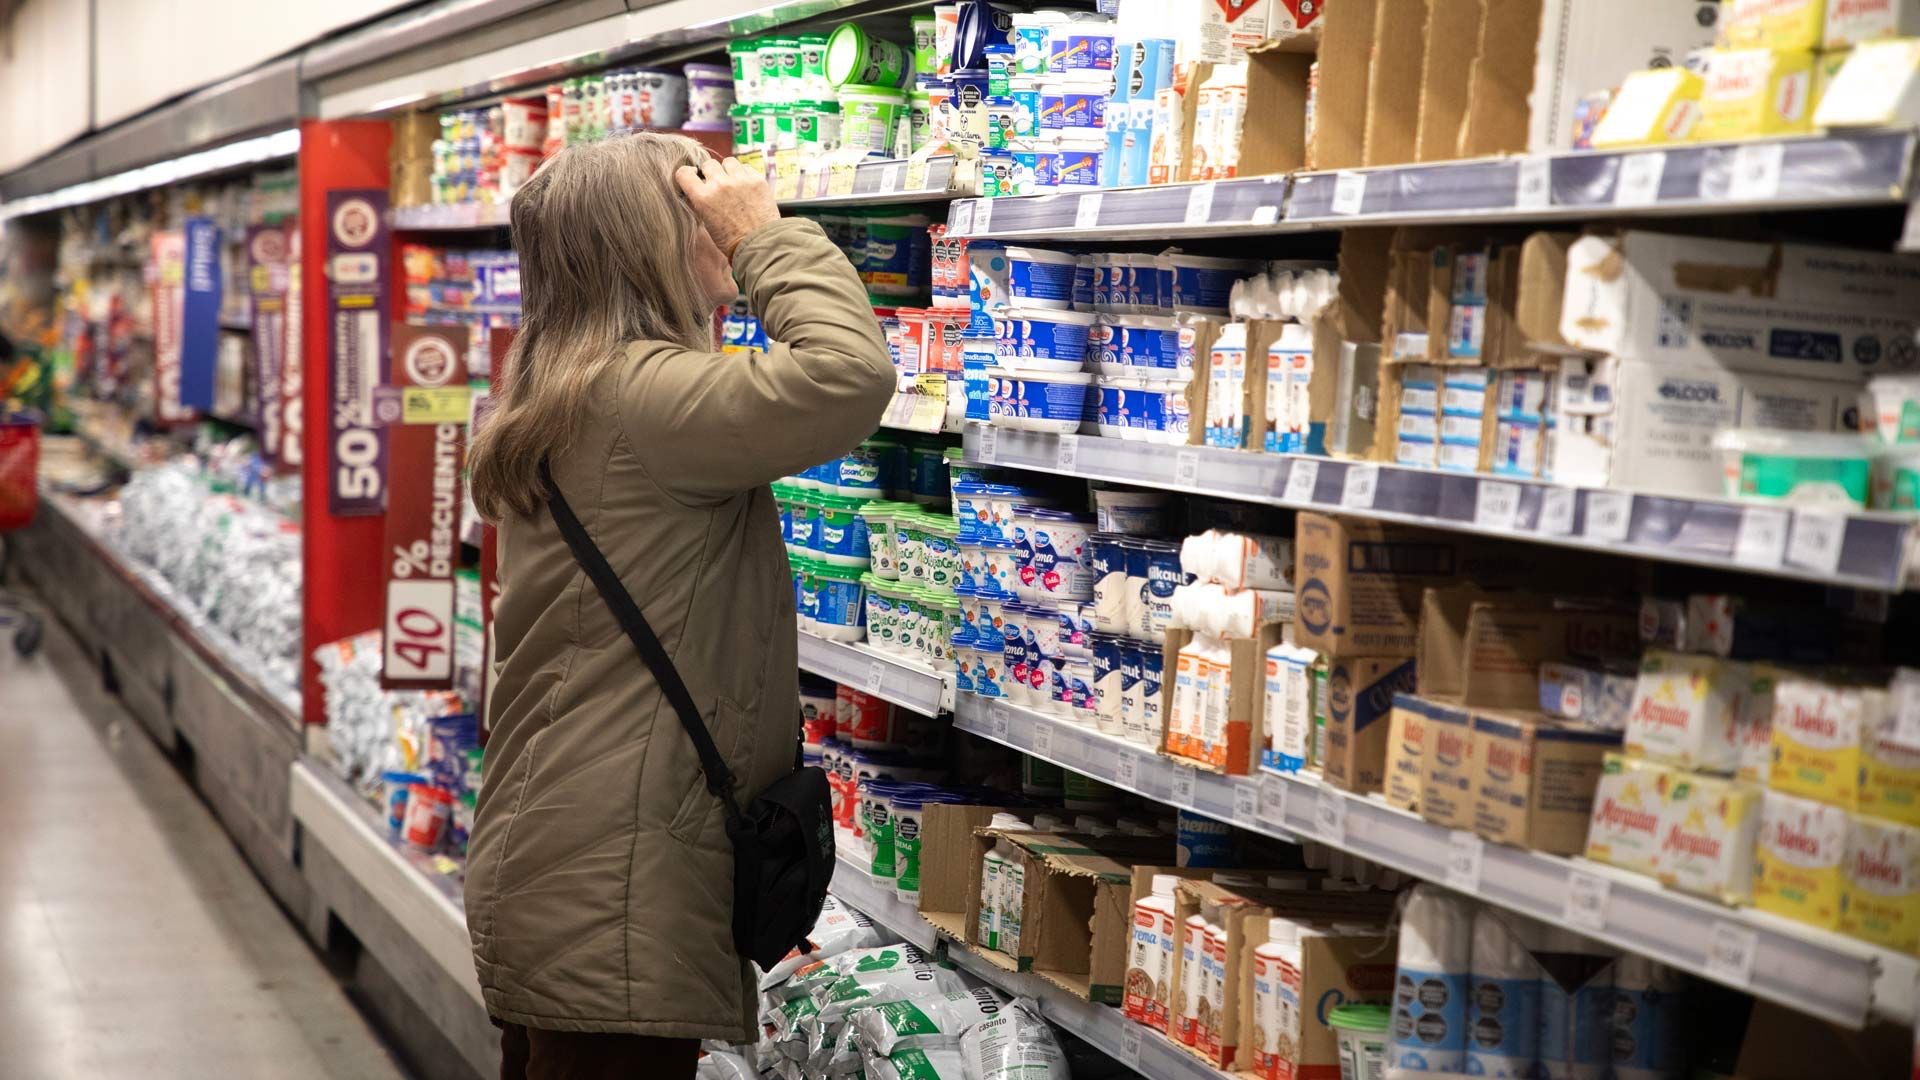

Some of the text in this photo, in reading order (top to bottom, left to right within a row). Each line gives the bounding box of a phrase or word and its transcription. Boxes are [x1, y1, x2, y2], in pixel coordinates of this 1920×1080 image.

[337, 429, 380, 499] 50
[393, 424, 457, 578] % DESCUENTO
[394, 608, 445, 670] 40
[978, 1017, 1007, 1033] casanto
